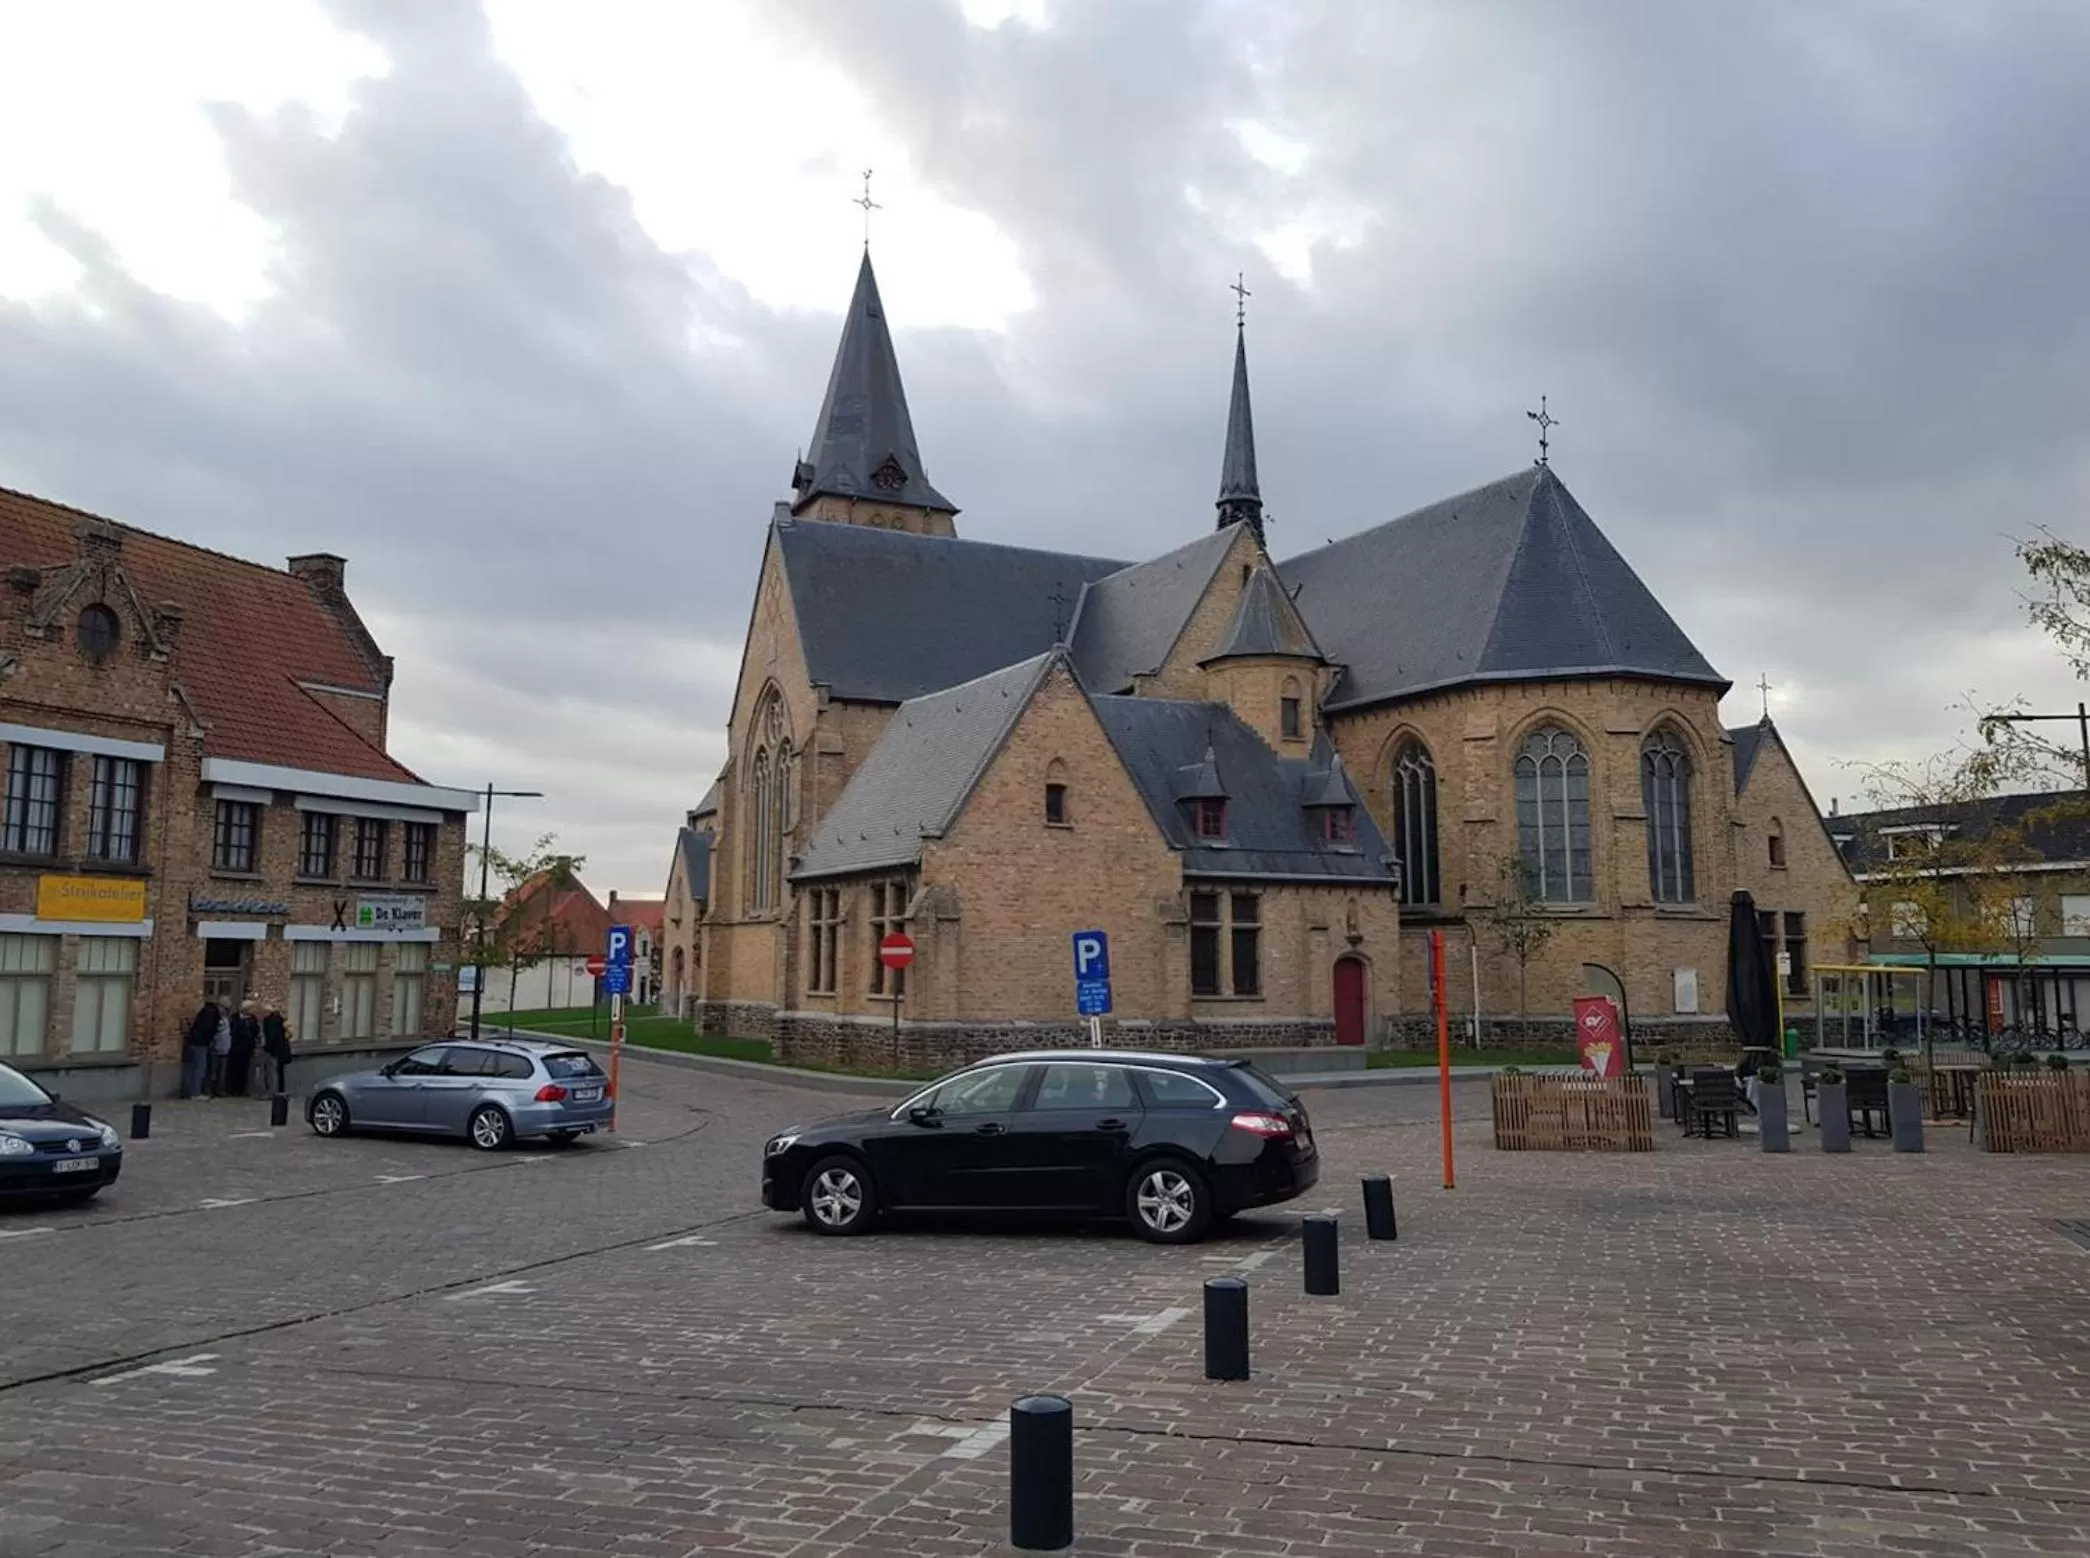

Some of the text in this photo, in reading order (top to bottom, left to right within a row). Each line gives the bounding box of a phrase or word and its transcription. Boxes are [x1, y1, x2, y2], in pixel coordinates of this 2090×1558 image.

[375, 907, 424, 921] De Klaver
[610, 931, 627, 960] P
[1078, 938, 1101, 974] P
